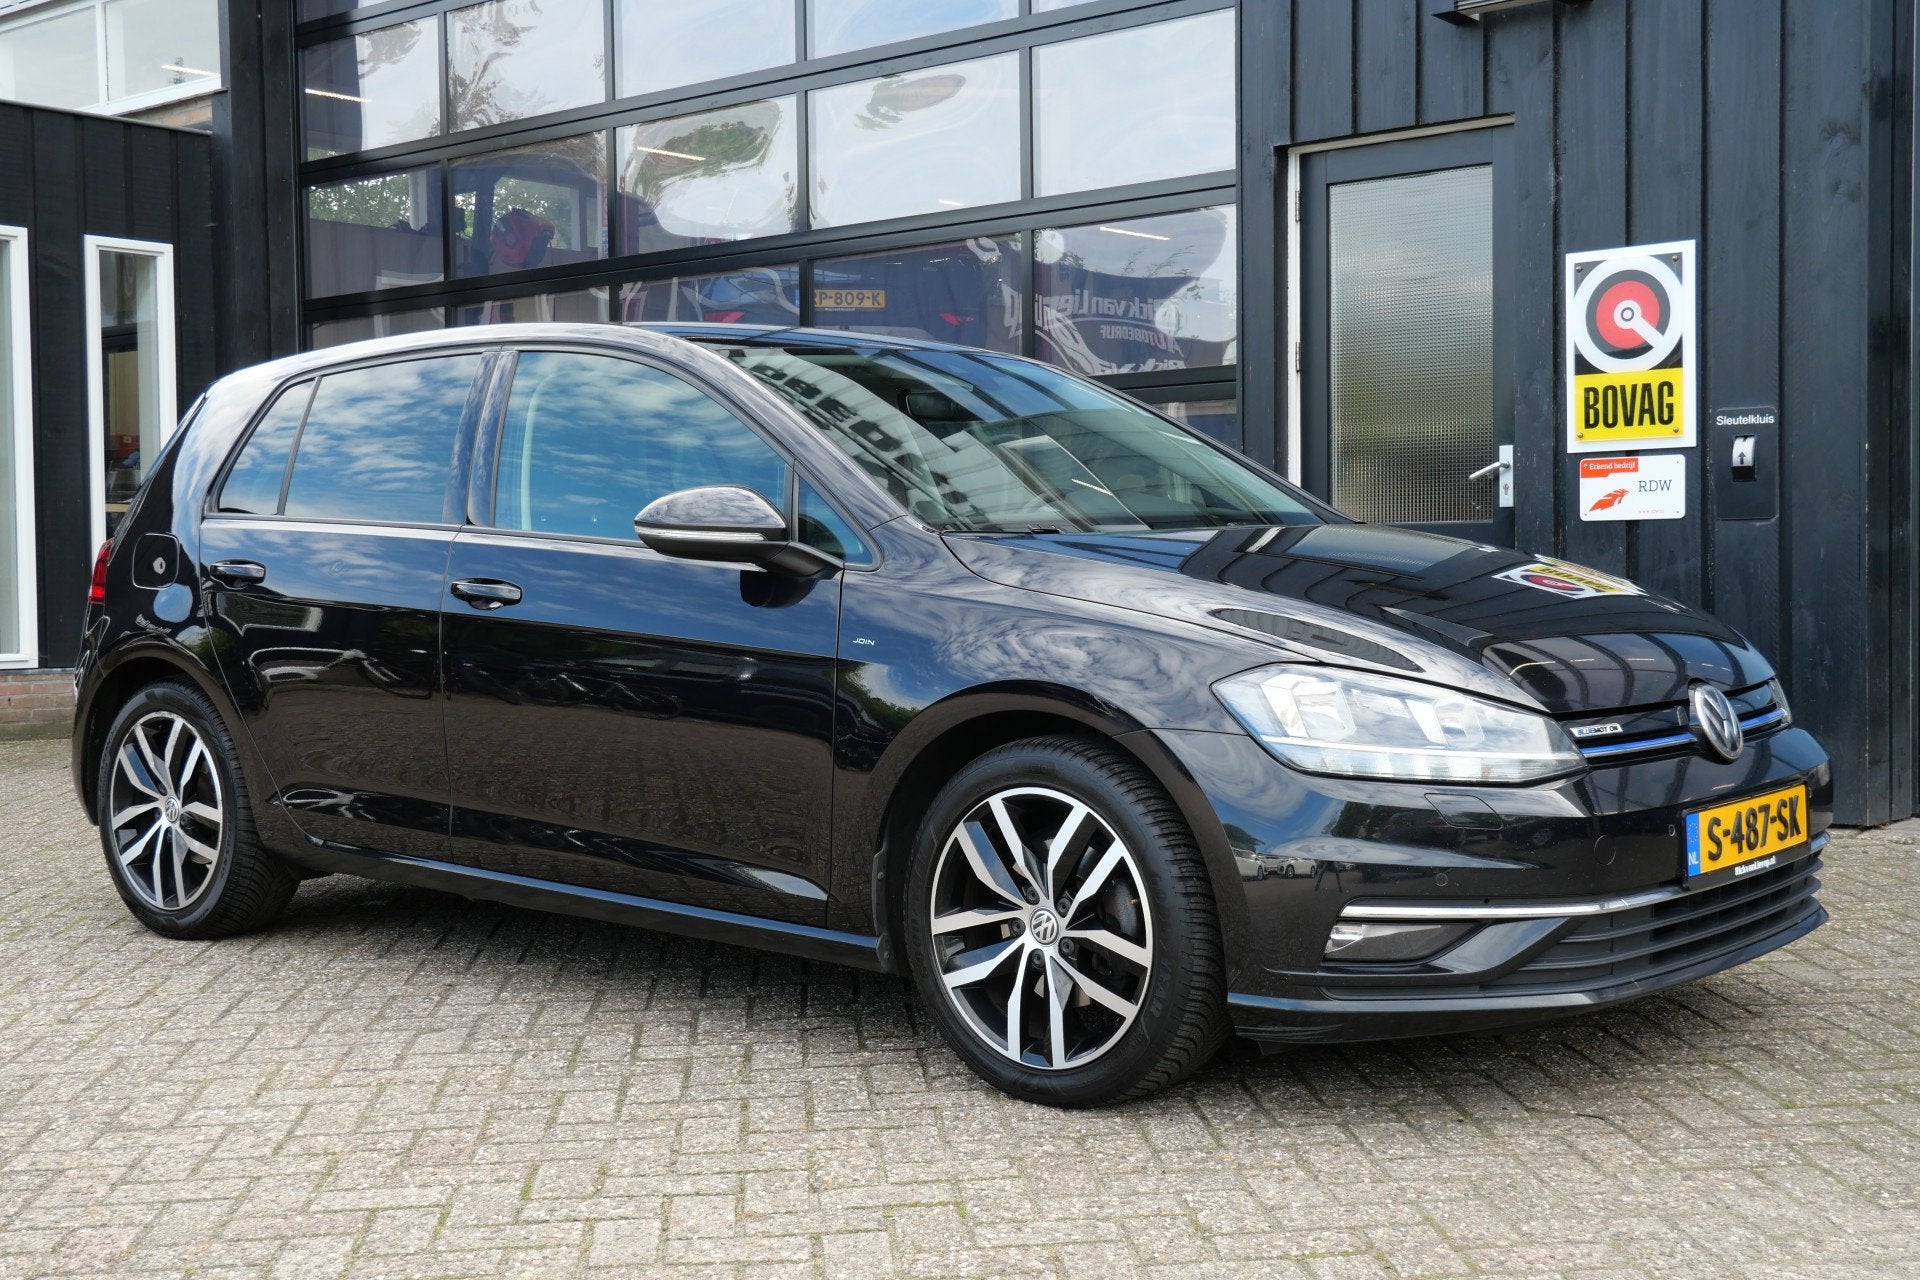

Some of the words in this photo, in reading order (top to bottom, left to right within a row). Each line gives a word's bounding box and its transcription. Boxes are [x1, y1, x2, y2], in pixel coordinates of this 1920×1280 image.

[1584, 381, 1674, 430] BOVAG
[1716, 414, 1775, 426] Sleutelkluis
[1589, 462, 1613, 470] Erkend
[1614, 461, 1636, 470] bedrijf
[1638, 479, 1673, 493] RDW
[852, 637, 875, 646] JOIN
[1577, 725, 1619, 735] BLUEMOTON
[1708, 795, 1802, 861] S-487-SK
[1688, 851, 1699, 866] NL
